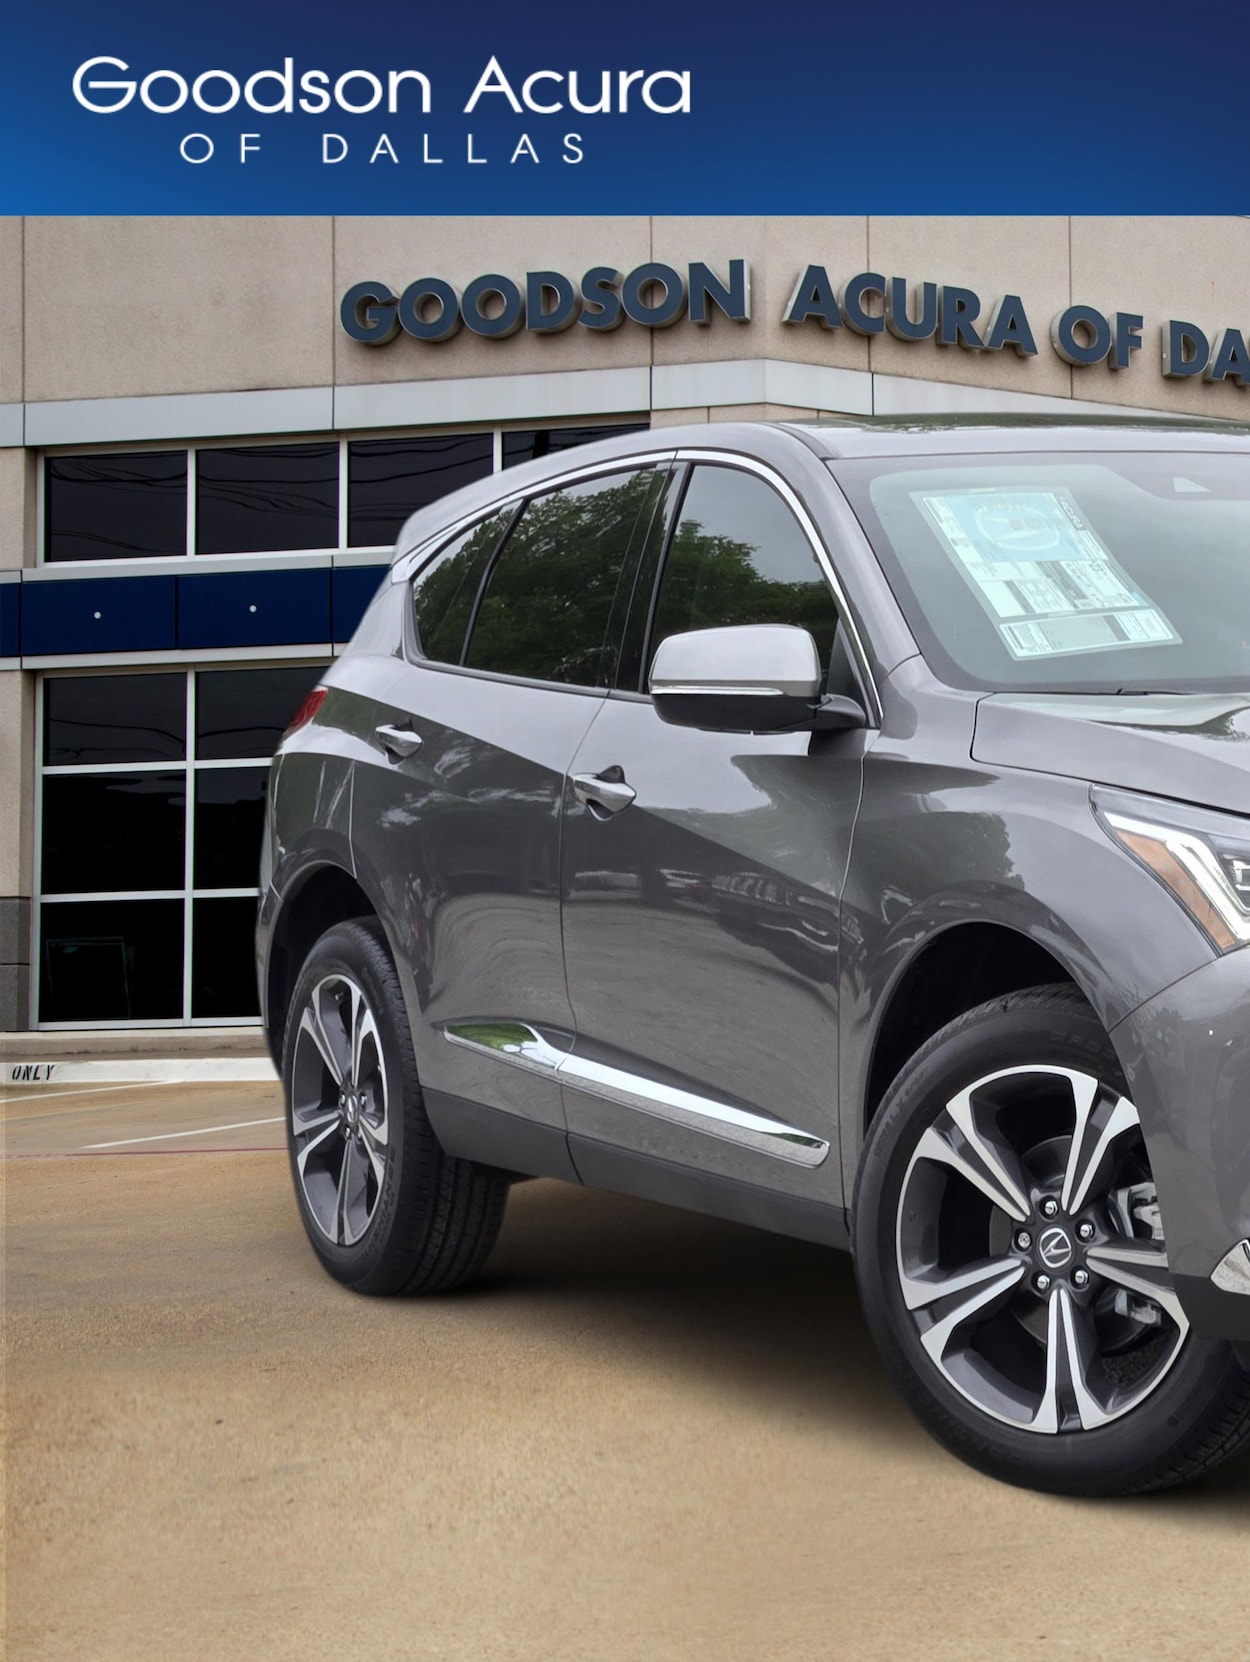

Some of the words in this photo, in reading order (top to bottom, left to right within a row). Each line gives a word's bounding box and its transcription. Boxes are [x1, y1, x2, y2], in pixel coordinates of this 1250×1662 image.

[340, 259, 751, 346] GOODSON
[784, 265, 1038, 356] ACURA
[1052, 305, 1144, 369] OF
[12, 1065, 54, 1081] ONLY
